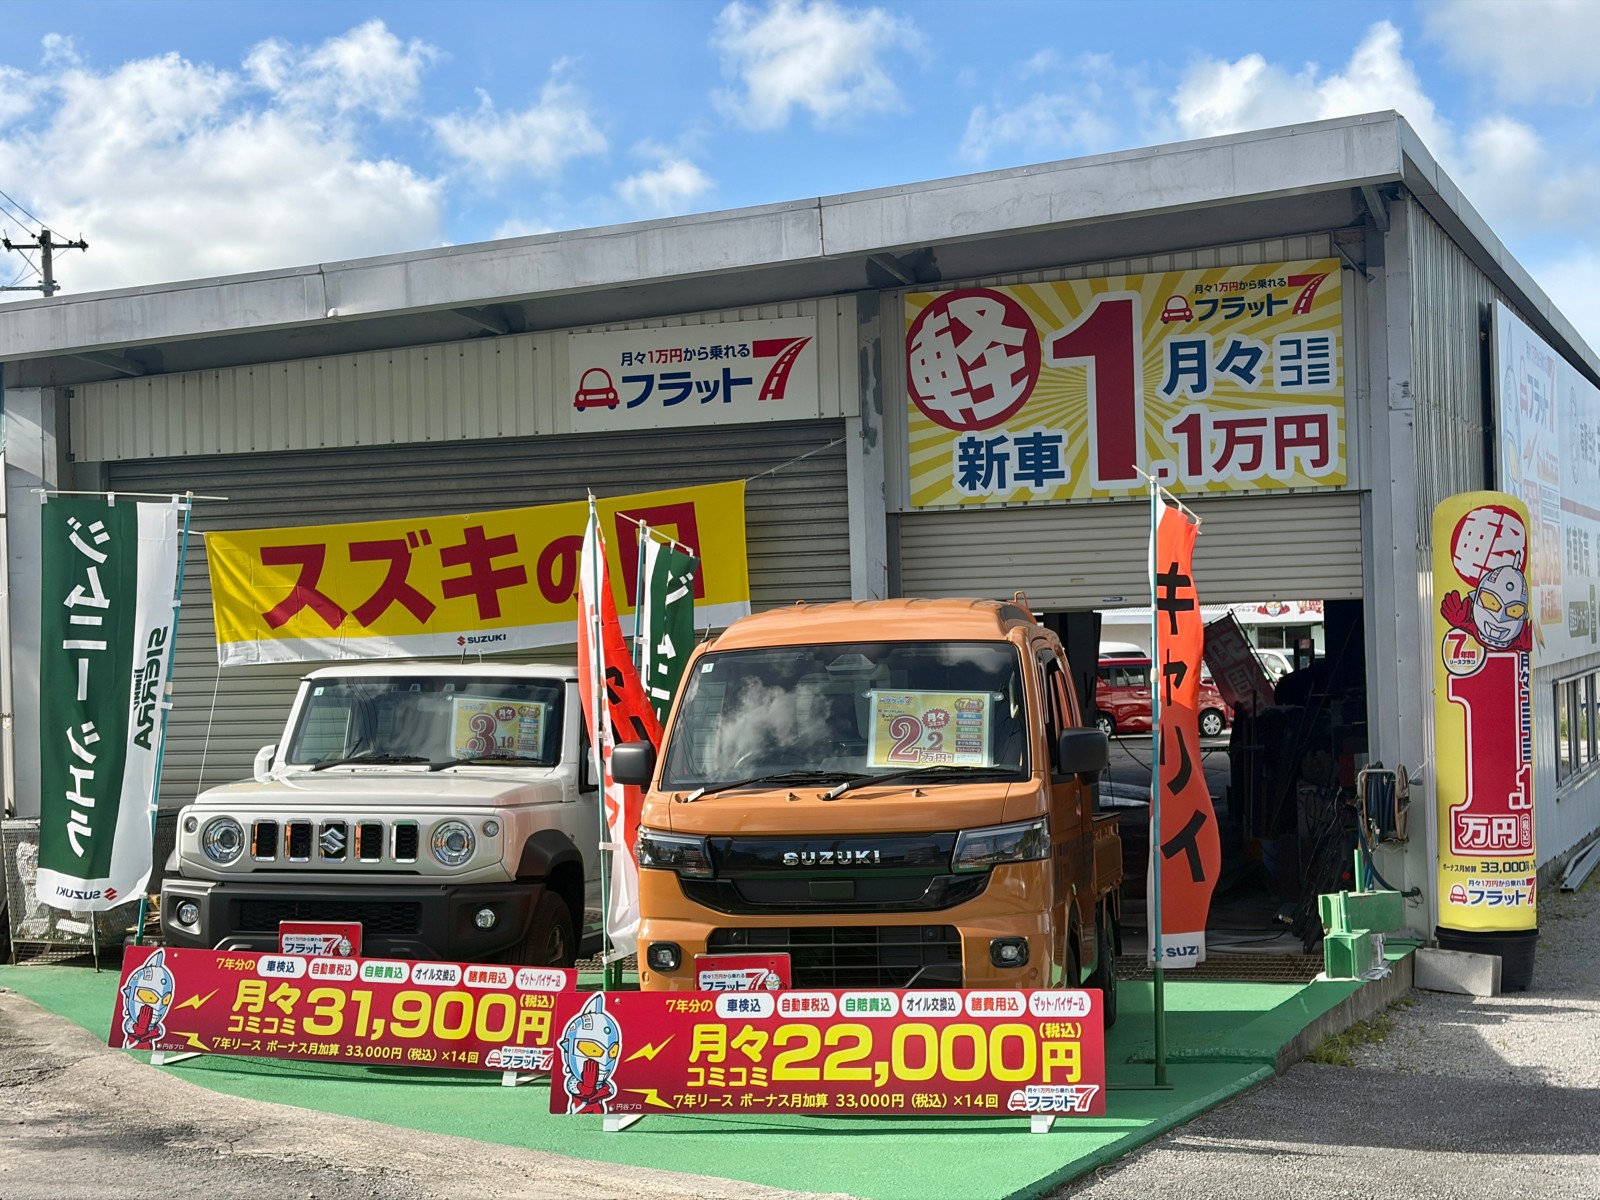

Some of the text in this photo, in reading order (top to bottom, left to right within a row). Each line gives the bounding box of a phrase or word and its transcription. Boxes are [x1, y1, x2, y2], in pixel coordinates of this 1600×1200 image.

[1194, 277, 1287, 295] 月々1万円から乗れる
[620, 343, 750, 367] 月々1万円から乗れる
[910, 297, 1028, 425] 軽
[1163, 339, 1264, 396] 月々
[958, 432, 1066, 491] 新車
[467, 634, 507, 646] SUZUKI
[1460, 817, 1517, 845] 万円
[782, 849, 881, 866] SUZUKI
[1166, 946, 1199, 957] SUZ
[216, 957, 256, 971] 7年分の
[266, 960, 296, 973] 車検込
[312, 963, 352, 976] 自動車税込
[365, 965, 403, 979] 自賠責込
[415, 968, 456, 982] オイル交換込
[468, 970, 507, 985] 諸費用込
[232, 979, 301, 1015] 月々
[520, 994, 555, 1009] (税込)
[666, 999, 713, 1014] 7年分の
[726, 998, 761, 1012] 車検込
[781, 998, 830, 1012] 自動車税込
[845, 998, 892, 1012] 自賠責込
[906, 997, 956, 1012] オイル交換込
[971, 997, 1019, 1012] 諸費用込
[228, 1015, 296, 1036] コミコミ
[212, 1037, 479, 1064] 7年リース ボーナス月加算 33,000円 (税込) ×14回
[688, 1024, 769, 1063] 月々
[1039, 1022, 1082, 1039] (税込)
[686, 1067, 768, 1087] コミコミ
[673, 1093, 998, 1108] 7年リース ボーナス月加算 33,000円 (税込) ×14回
